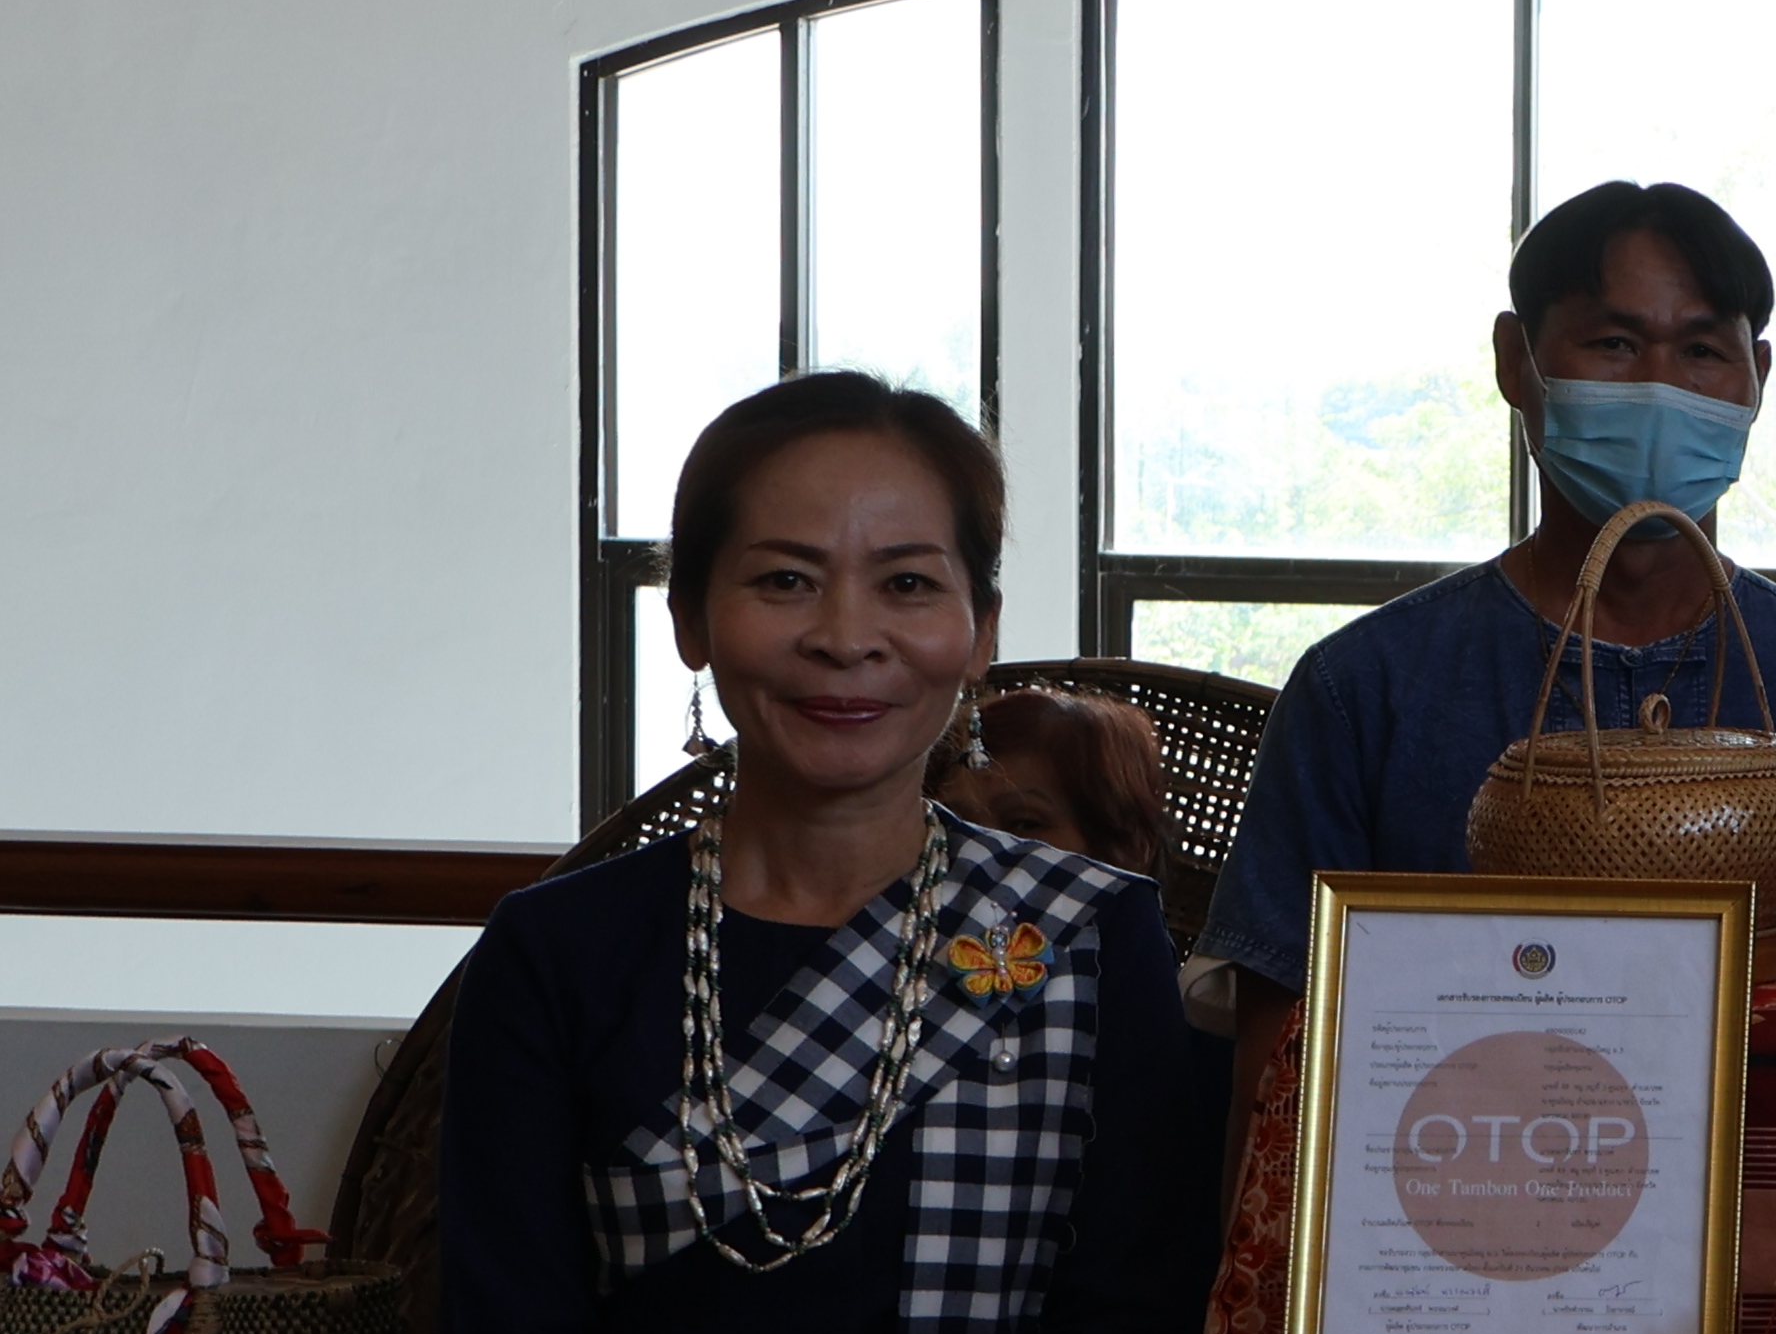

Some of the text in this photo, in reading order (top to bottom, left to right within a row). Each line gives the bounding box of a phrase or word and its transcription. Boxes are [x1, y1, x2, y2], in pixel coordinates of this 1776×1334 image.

[1604, 996, 1627, 1005] OTOP
[1408, 1113, 1636, 1165] OTOP
[1405, 1179, 1441, 1197] One
[1448, 1178, 1517, 1197] Tambon
[1523, 1179, 1560, 1198] One
[1567, 1179, 1633, 1199] Product
